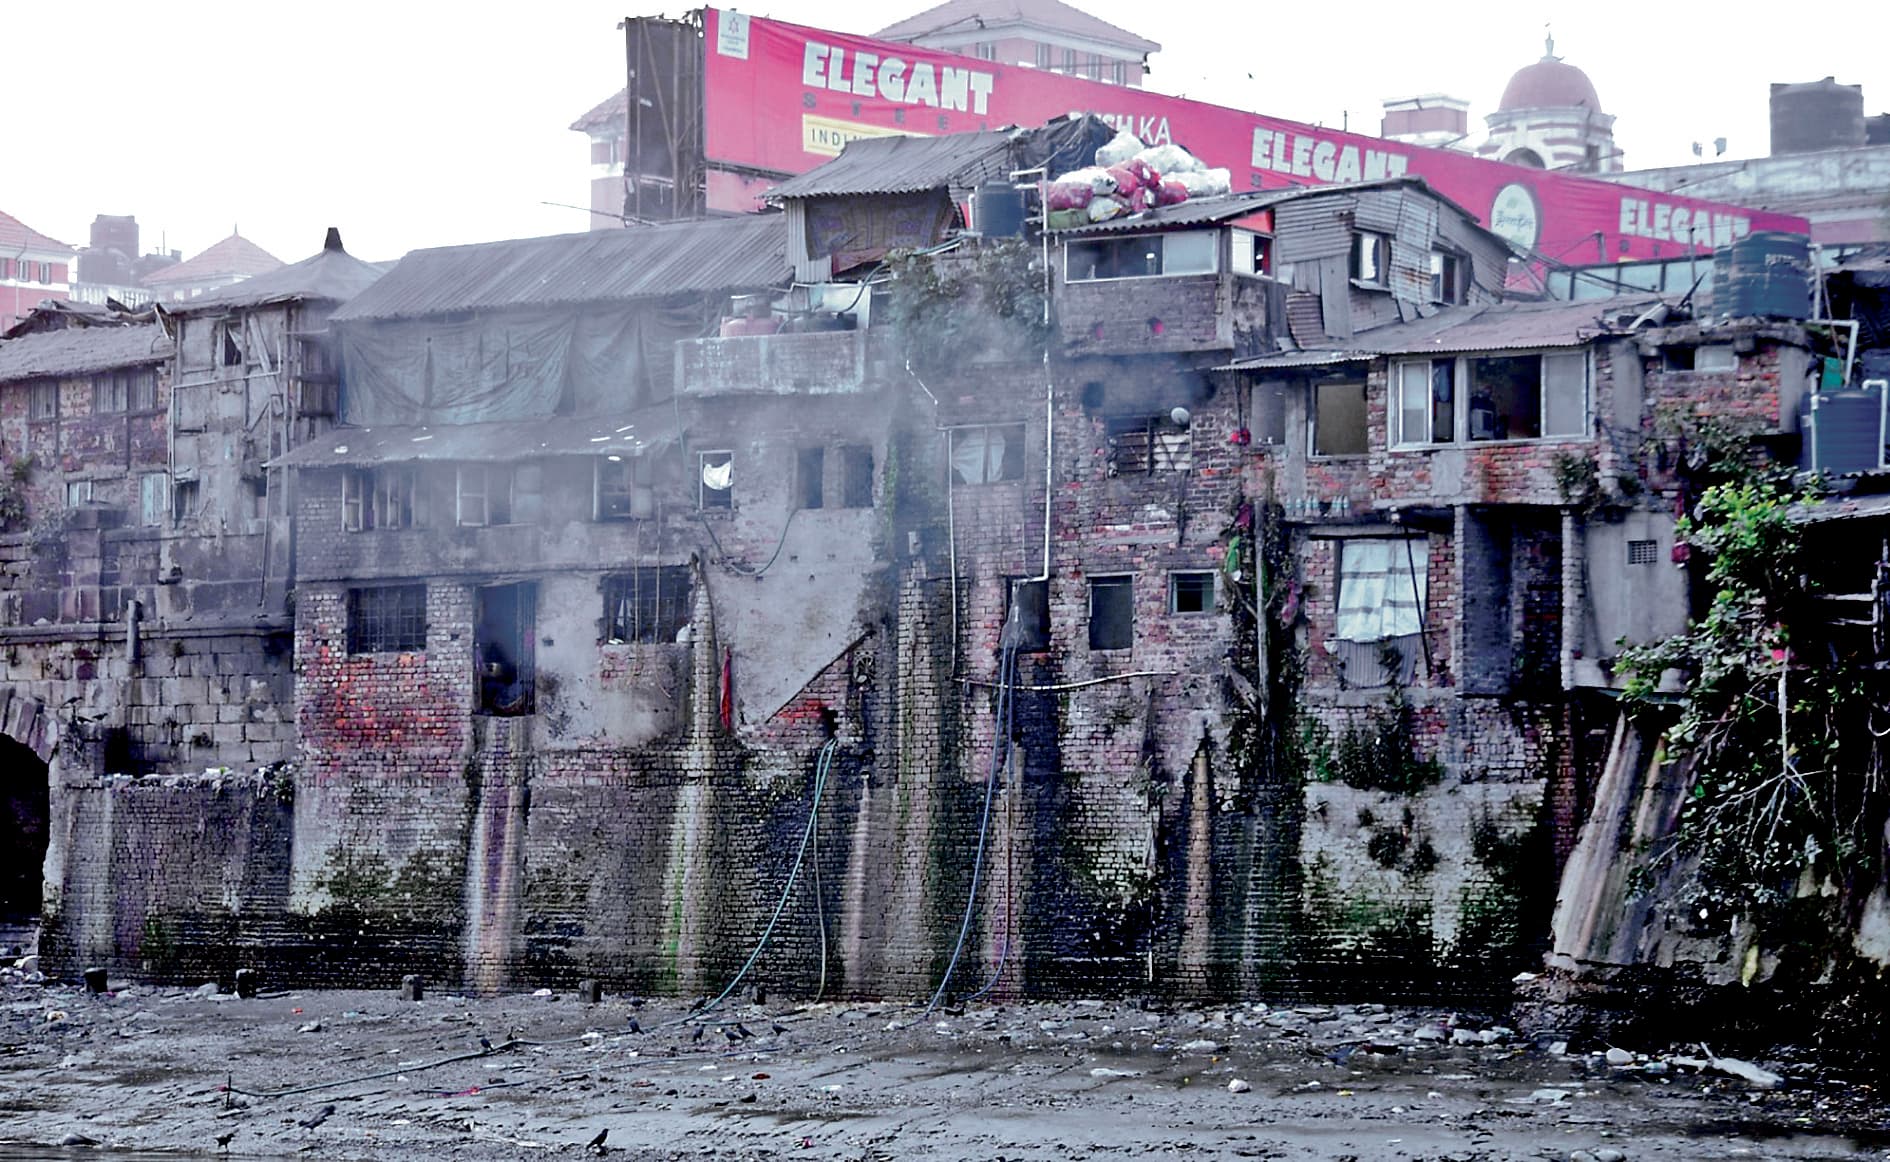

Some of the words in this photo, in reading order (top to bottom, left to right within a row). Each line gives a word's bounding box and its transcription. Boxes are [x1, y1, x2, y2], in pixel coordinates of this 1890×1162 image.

[803, 41, 993, 115] ELEGANT
[1252, 127, 1408, 184] ELEGANT
[1619, 198, 1750, 248] ELEGANT
